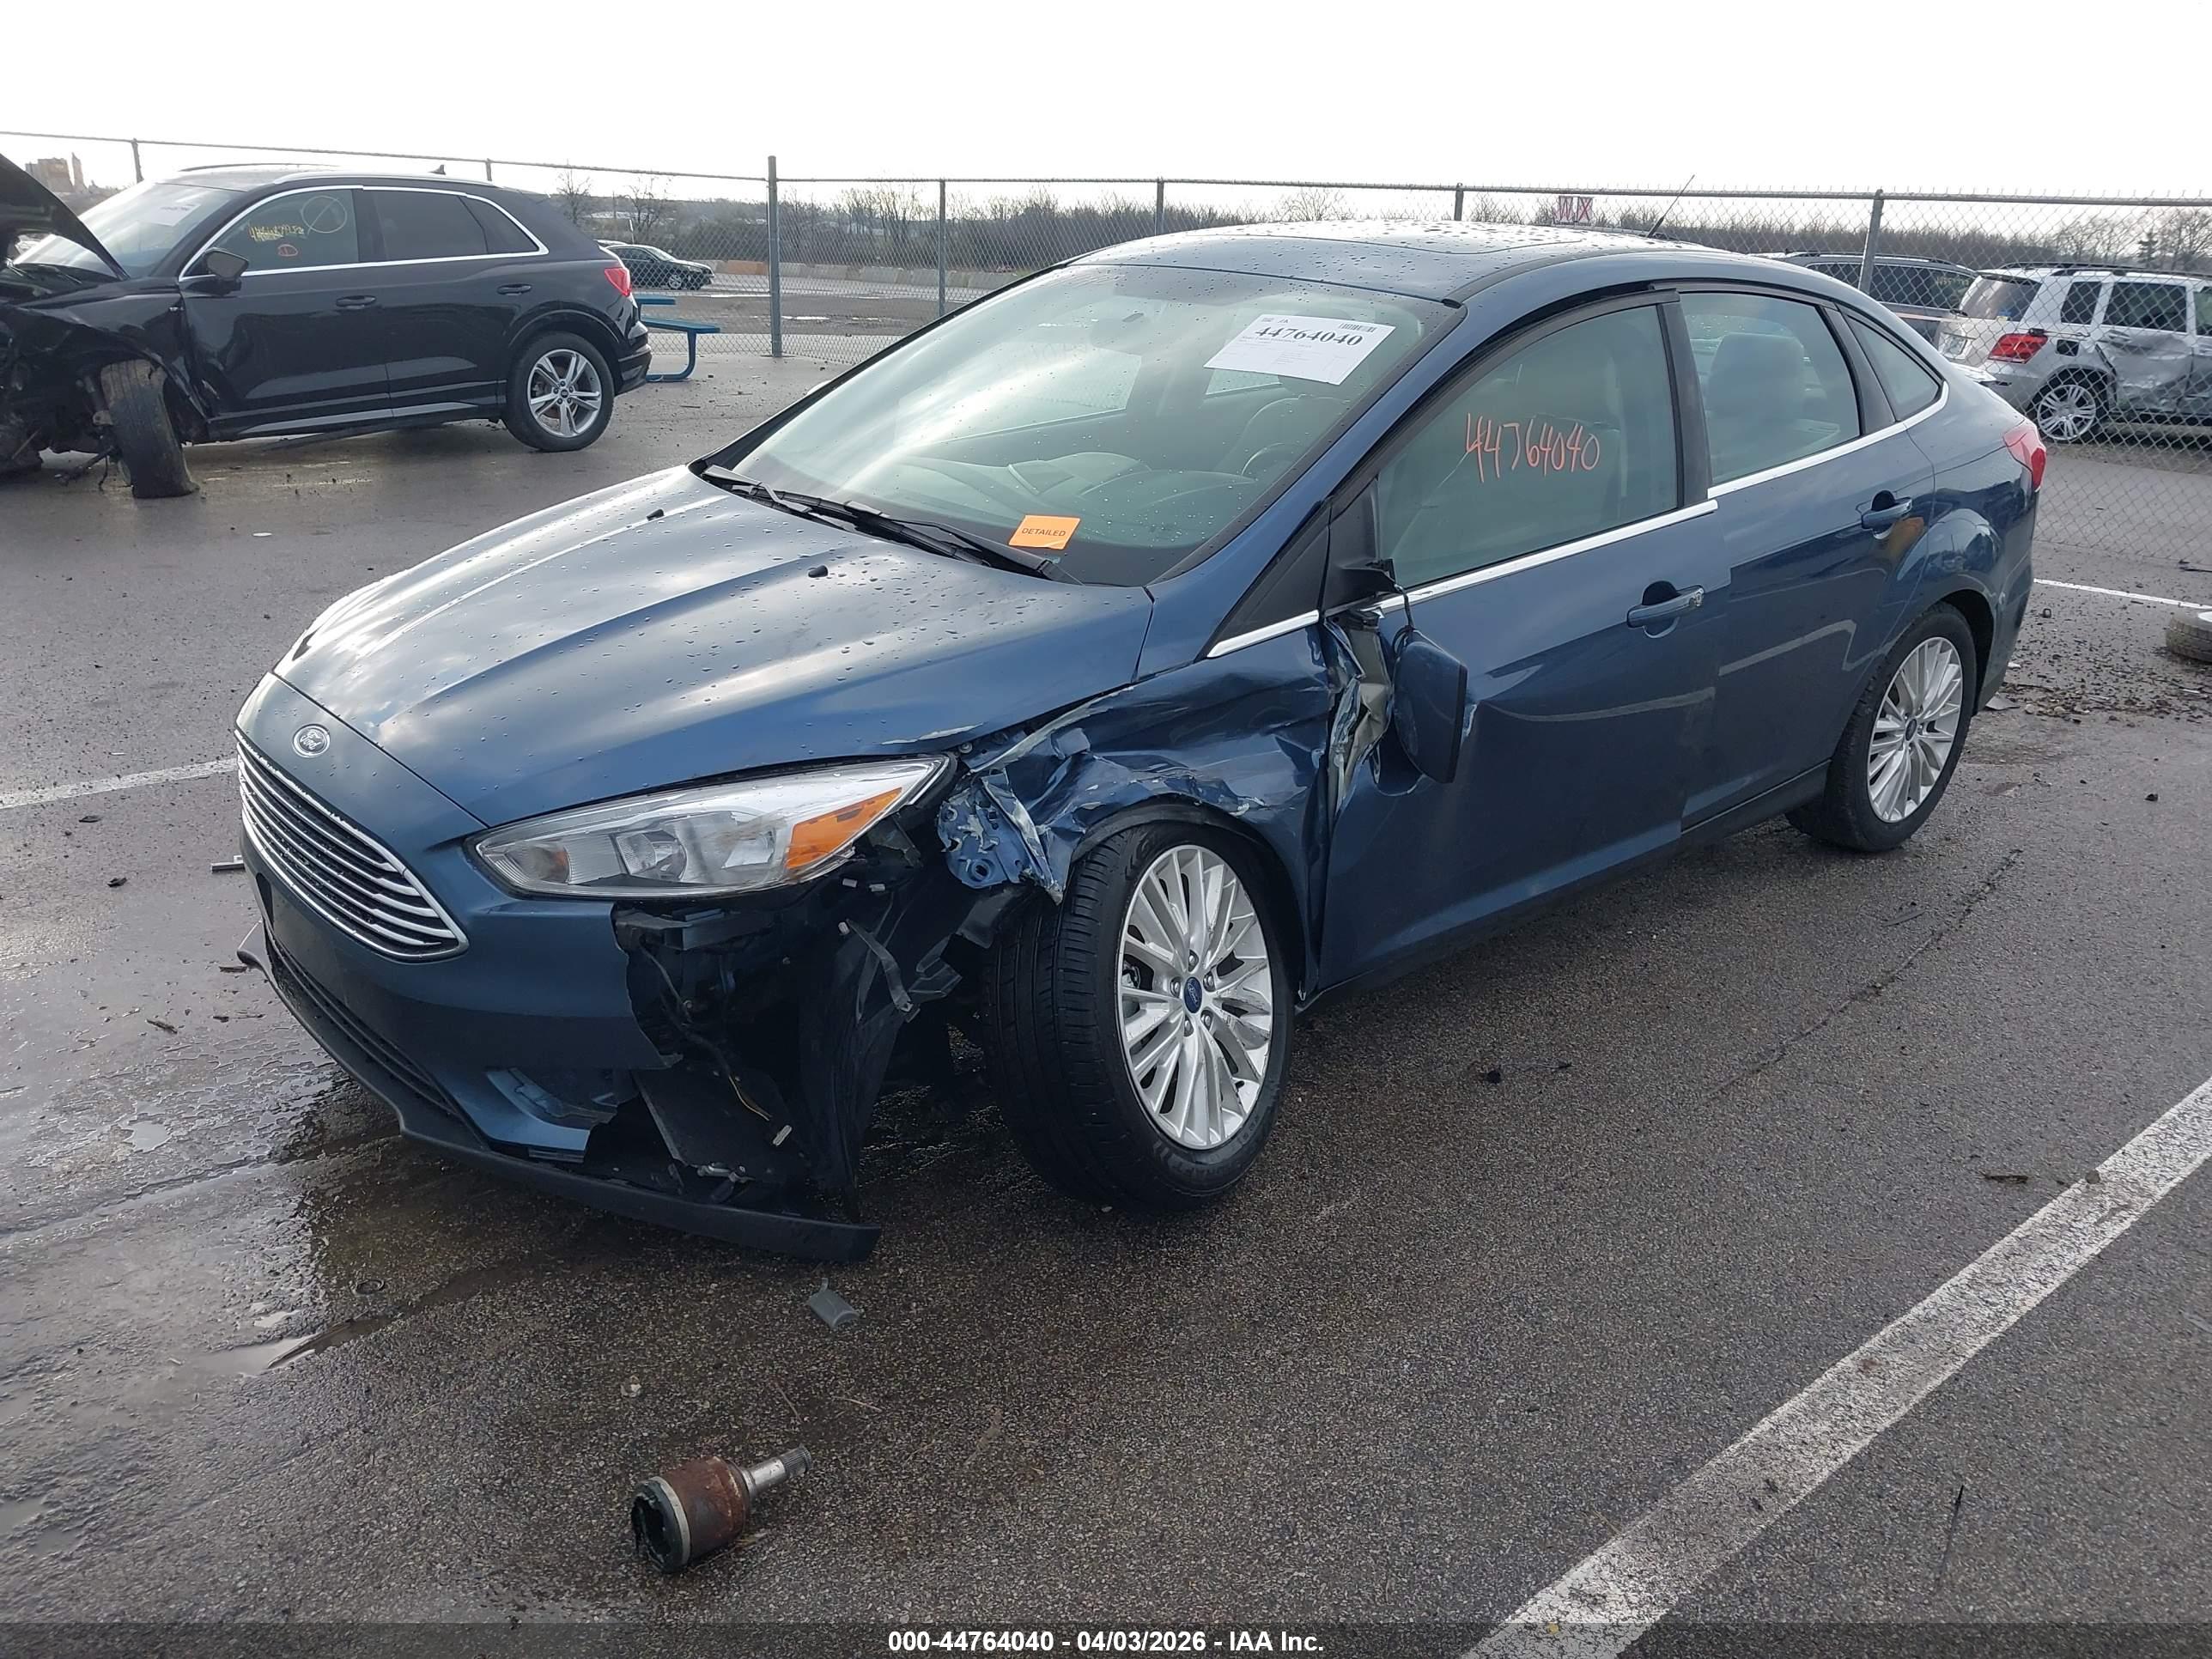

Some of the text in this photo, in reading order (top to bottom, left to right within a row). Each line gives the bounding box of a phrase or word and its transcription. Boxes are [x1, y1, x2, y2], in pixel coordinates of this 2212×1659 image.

[1254, 325, 1364, 347] 44764040
[1465, 412, 1601, 483] 44764040
[1021, 527, 1066, 537] DETAILED
